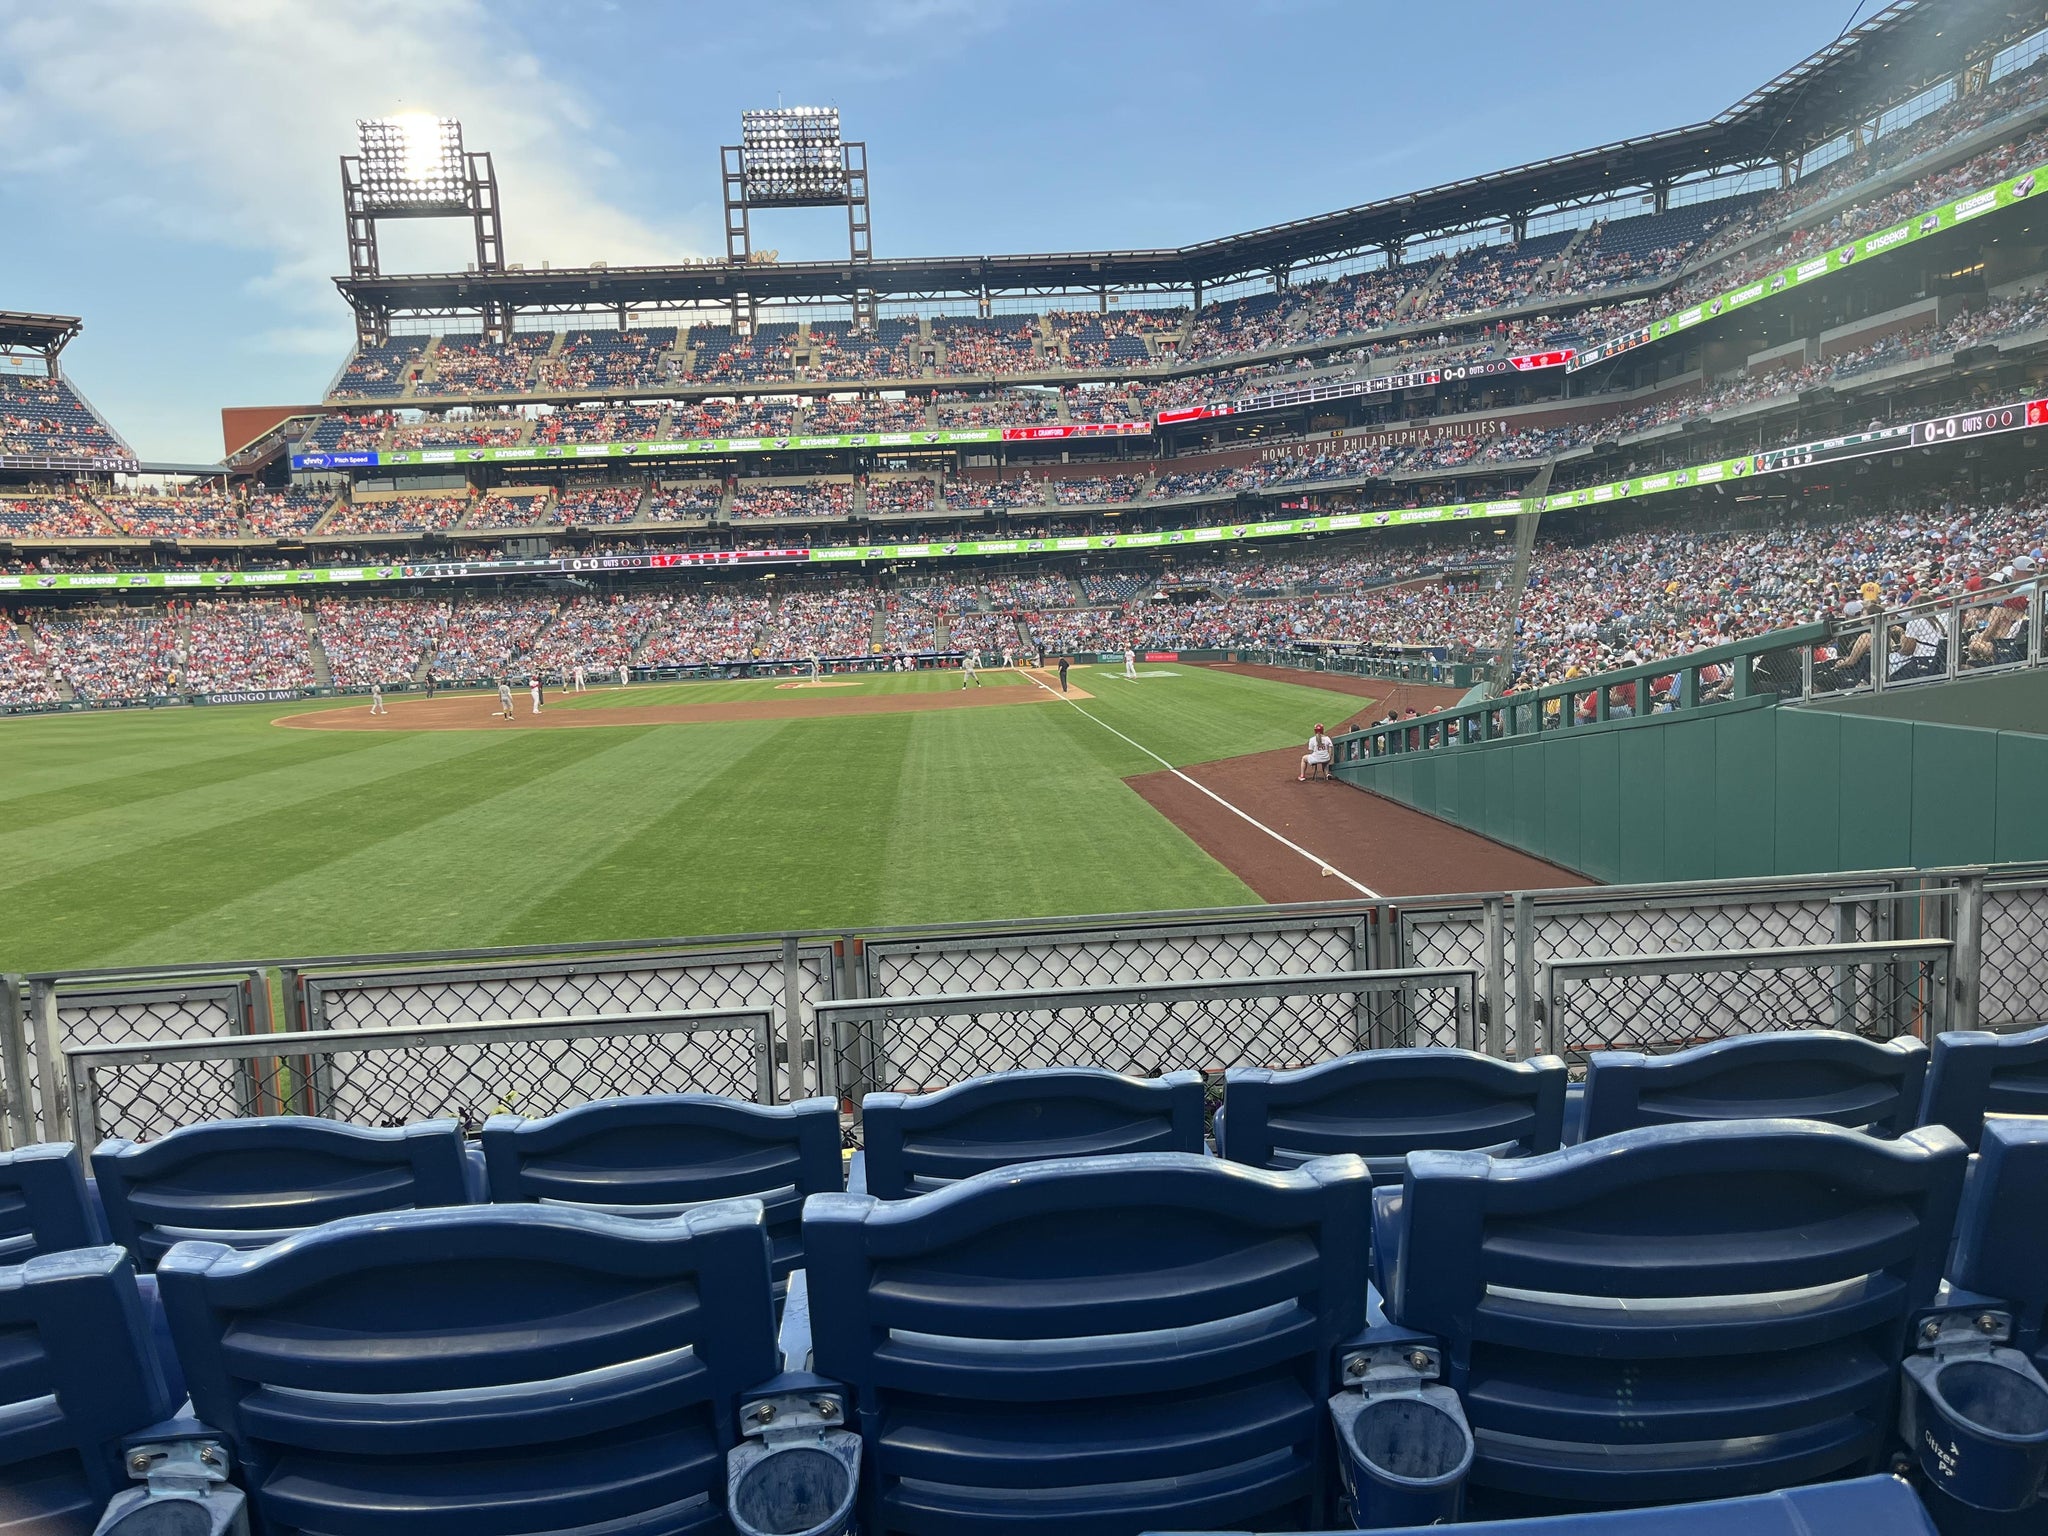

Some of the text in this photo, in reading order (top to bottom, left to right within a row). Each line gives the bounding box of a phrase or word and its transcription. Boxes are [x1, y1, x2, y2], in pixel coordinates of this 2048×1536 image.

[1955, 189, 1997, 214] sunseeker
[1865, 226, 1910, 252] sunseeker
[1730, 285, 1763, 305] sunseeker
[1444, 365, 1485, 381] 0-0 OUTS
[1925, 416, 1982, 441] 0-0 OUTS
[949, 431, 989, 440] sunseeker
[1262, 446, 1292, 461] HOME
[1317, 441, 1337, 454] THE
[1344, 430, 1430, 453] PHILADELPHIA
[1438, 420, 1496, 440] PHILLIES
[800, 437, 840, 446] sunseeker
[648, 443, 689, 452] sunseeker
[495, 449, 536, 458] sunseeker
[303, 457, 324, 465] xfinity
[334, 455, 368, 465] Pitch Speed
[1400, 510, 1442, 521] sunseeker
[1256, 523, 1293, 533] sunseeker
[1126, 535, 1162, 545] sunseeker
[977, 543, 1018, 552] sunseeker
[817, 549, 858, 559] sunseeker
[572, 558, 619, 570] 0-0 OUTS
[69, 575, 118, 585] sunseeker
[244, 573, 287, 582] sunseeker
[212, 690, 291, 704] GRUNGO LAW
